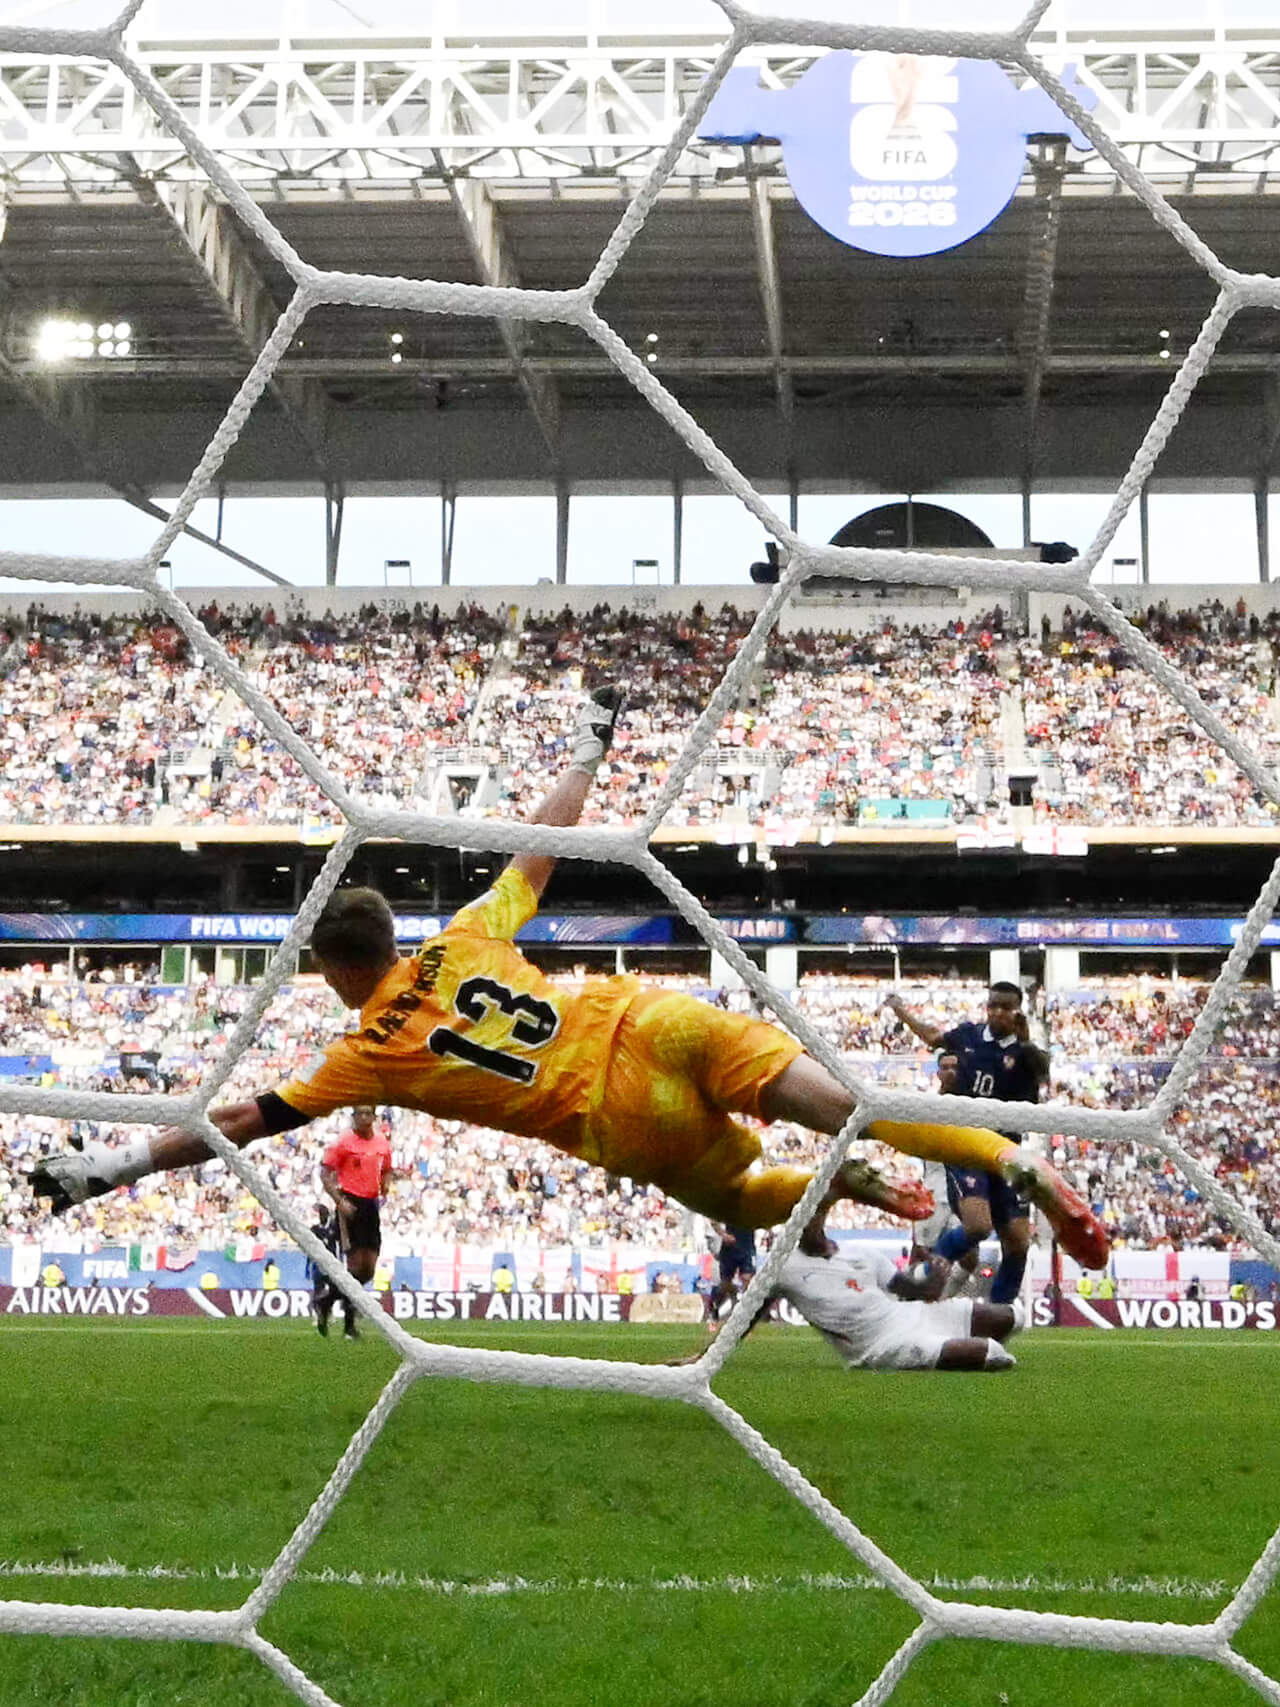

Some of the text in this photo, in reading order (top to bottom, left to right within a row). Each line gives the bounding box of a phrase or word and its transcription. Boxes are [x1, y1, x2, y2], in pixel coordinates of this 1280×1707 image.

[882, 150, 928, 165] FIFA
[849, 185, 959, 201] WORLD CUP
[848, 201, 958, 227] 2026
[189, 915, 236, 937] FIFA
[1017, 922, 1109, 939] BRONZE
[426, 974, 561, 1087] 13
[972, 1069, 995, 1097] 10
[81, 1259, 129, 1279] FIFA
[6, 1285, 151, 1316] AIRWAYS
[392, 1290, 478, 1320] BEST
[484, 1291, 622, 1322] AIRLINE
[1116, 1300, 1277, 1330] WORLD'S
